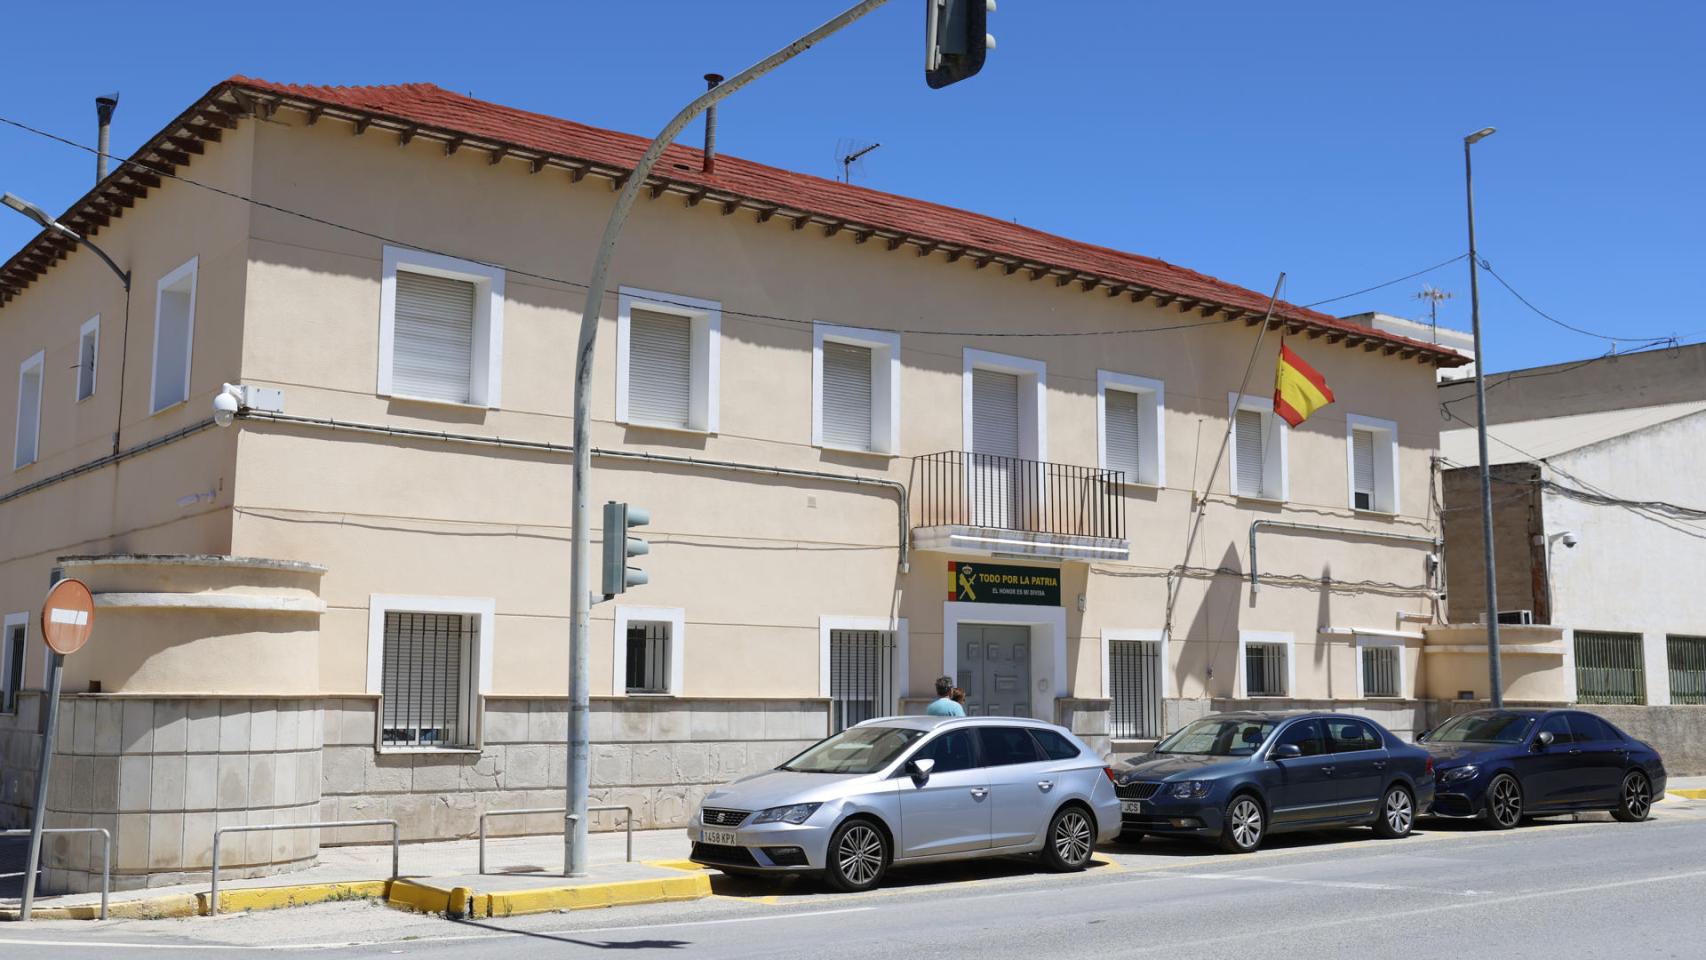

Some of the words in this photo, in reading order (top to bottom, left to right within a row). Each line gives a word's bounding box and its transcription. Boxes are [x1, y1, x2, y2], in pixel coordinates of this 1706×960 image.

[979, 573, 1001, 583] TODO
[1002, 575, 1018, 584] POR
[1020, 577, 1030, 585] LA
[1031, 577, 1057, 586] PATRIA
[704, 831, 720, 843] 1458
[721, 832, 735, 845] KPX
